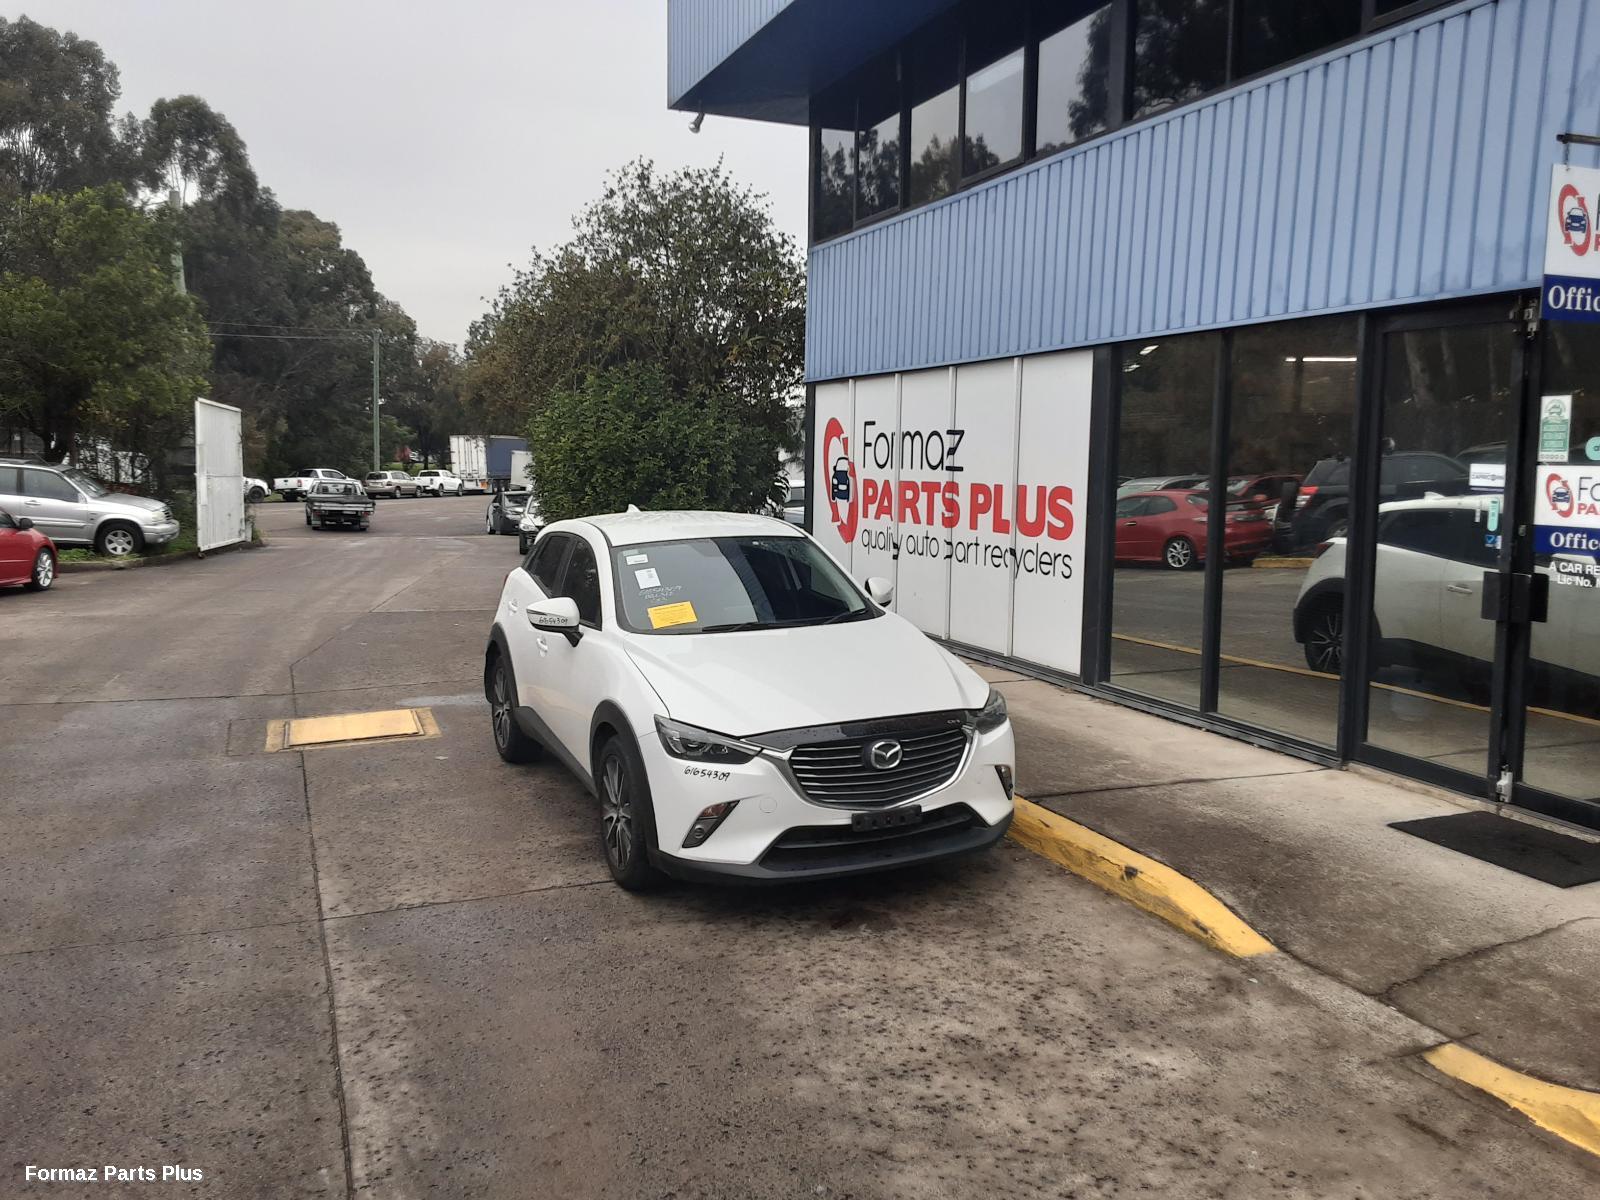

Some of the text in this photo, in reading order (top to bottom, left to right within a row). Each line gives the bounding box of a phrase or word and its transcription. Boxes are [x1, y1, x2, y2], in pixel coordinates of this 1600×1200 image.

[862, 421, 965, 472] Formaz
[862, 478, 1074, 541] PARTS PLUS
[1550, 531, 1600, 551] Offic
[861, 526, 903, 560] qualiy
[906, 530, 939, 558] auto
[984, 542, 1072, 579] recyclers
[1549, 561, 1557, 572] A
[1559, 562, 1583, 574] CAR
[1575, 576, 1593, 588] No.
[684, 765, 731, 782] 61654309
